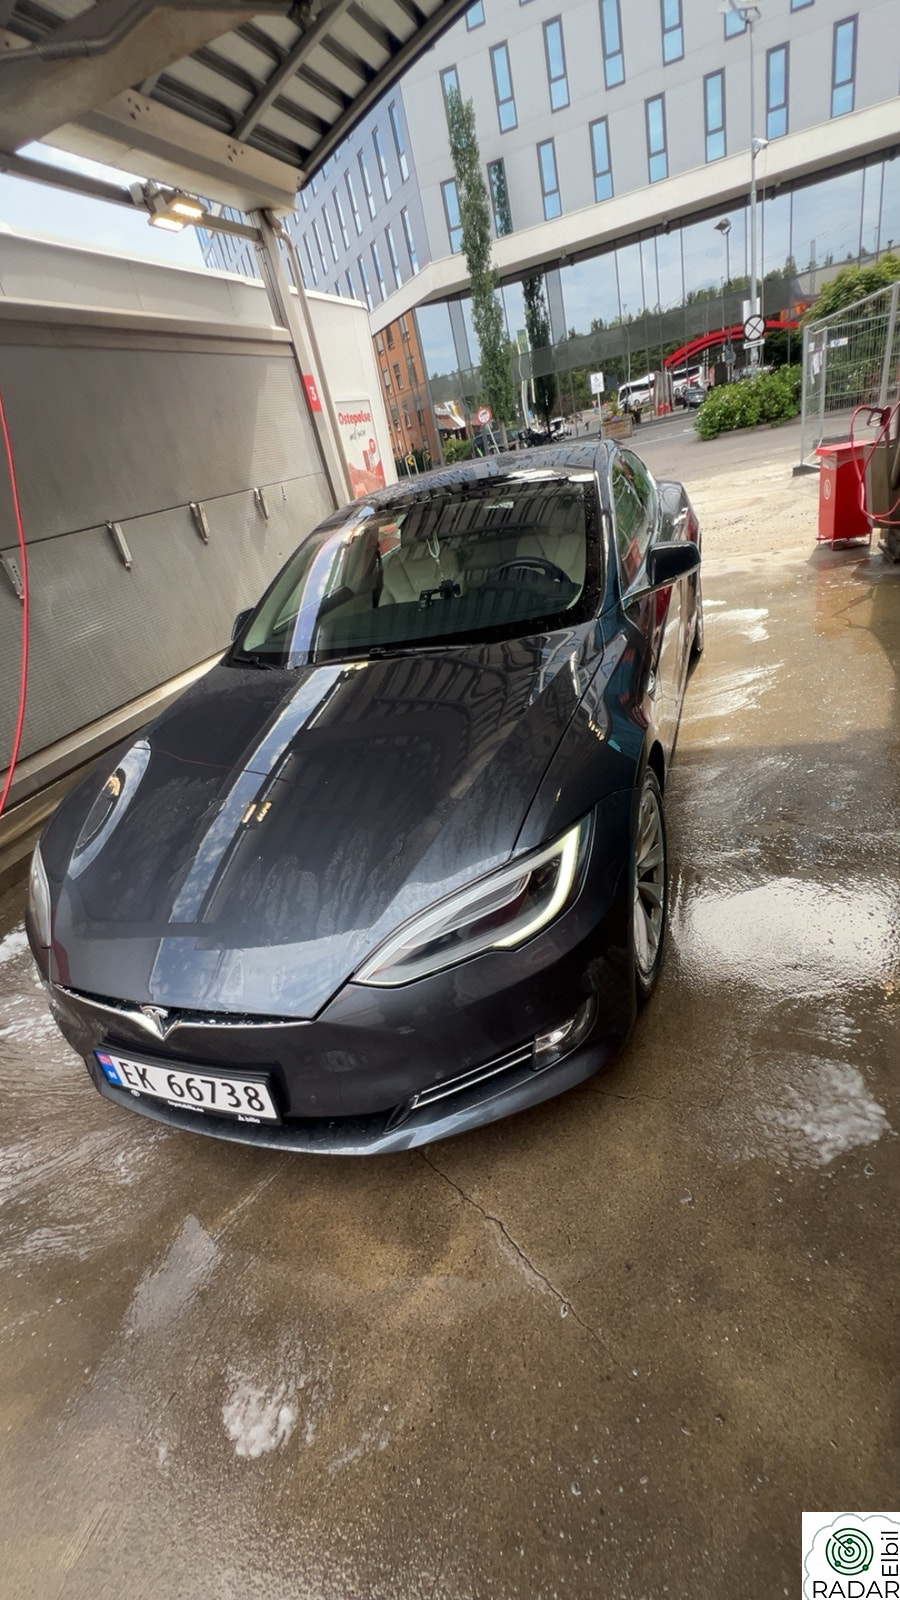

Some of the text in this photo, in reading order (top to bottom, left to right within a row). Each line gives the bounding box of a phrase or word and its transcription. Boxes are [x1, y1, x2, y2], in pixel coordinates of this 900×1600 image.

[309, 386, 318, 401] 3
[119, 1061, 265, 1112] EK 66738
